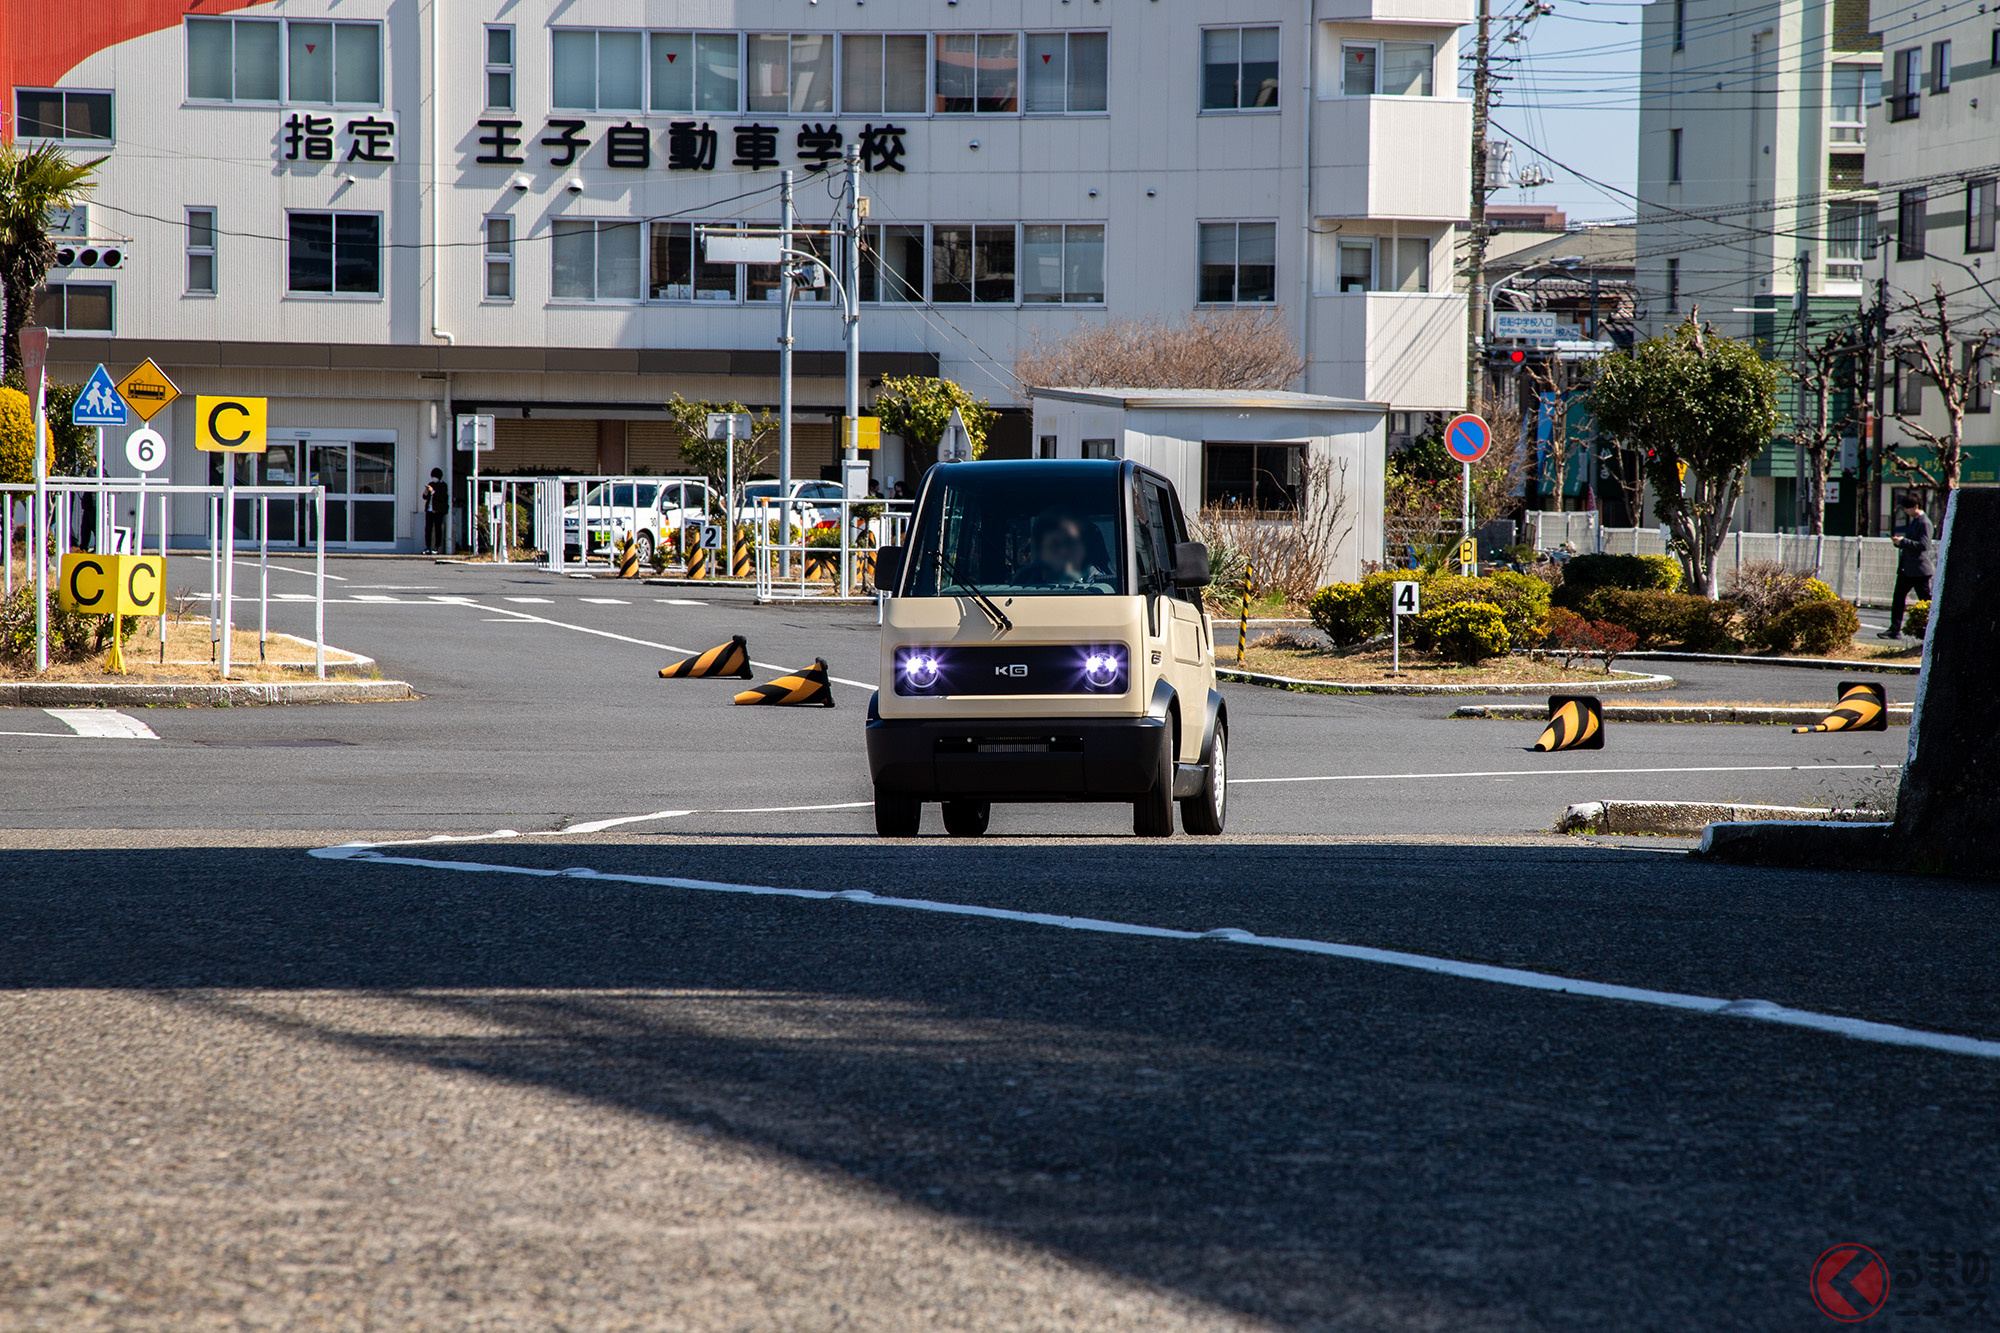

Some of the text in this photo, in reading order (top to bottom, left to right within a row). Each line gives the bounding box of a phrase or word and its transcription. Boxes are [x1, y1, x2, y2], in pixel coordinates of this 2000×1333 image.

[285, 113, 394, 162] 指定
[476, 118, 906, 173] 王子自動車学校
[208, 402, 251, 446] C
[138, 439, 154, 462] 6
[114, 529, 126, 554] 7
[704, 527, 717, 548] 2
[1463, 541, 1473, 562] B
[70, 560, 105, 606] C
[128, 563, 155, 607] C
[1397, 584, 1415, 612] 4
[995, 664, 1028, 677] KG
